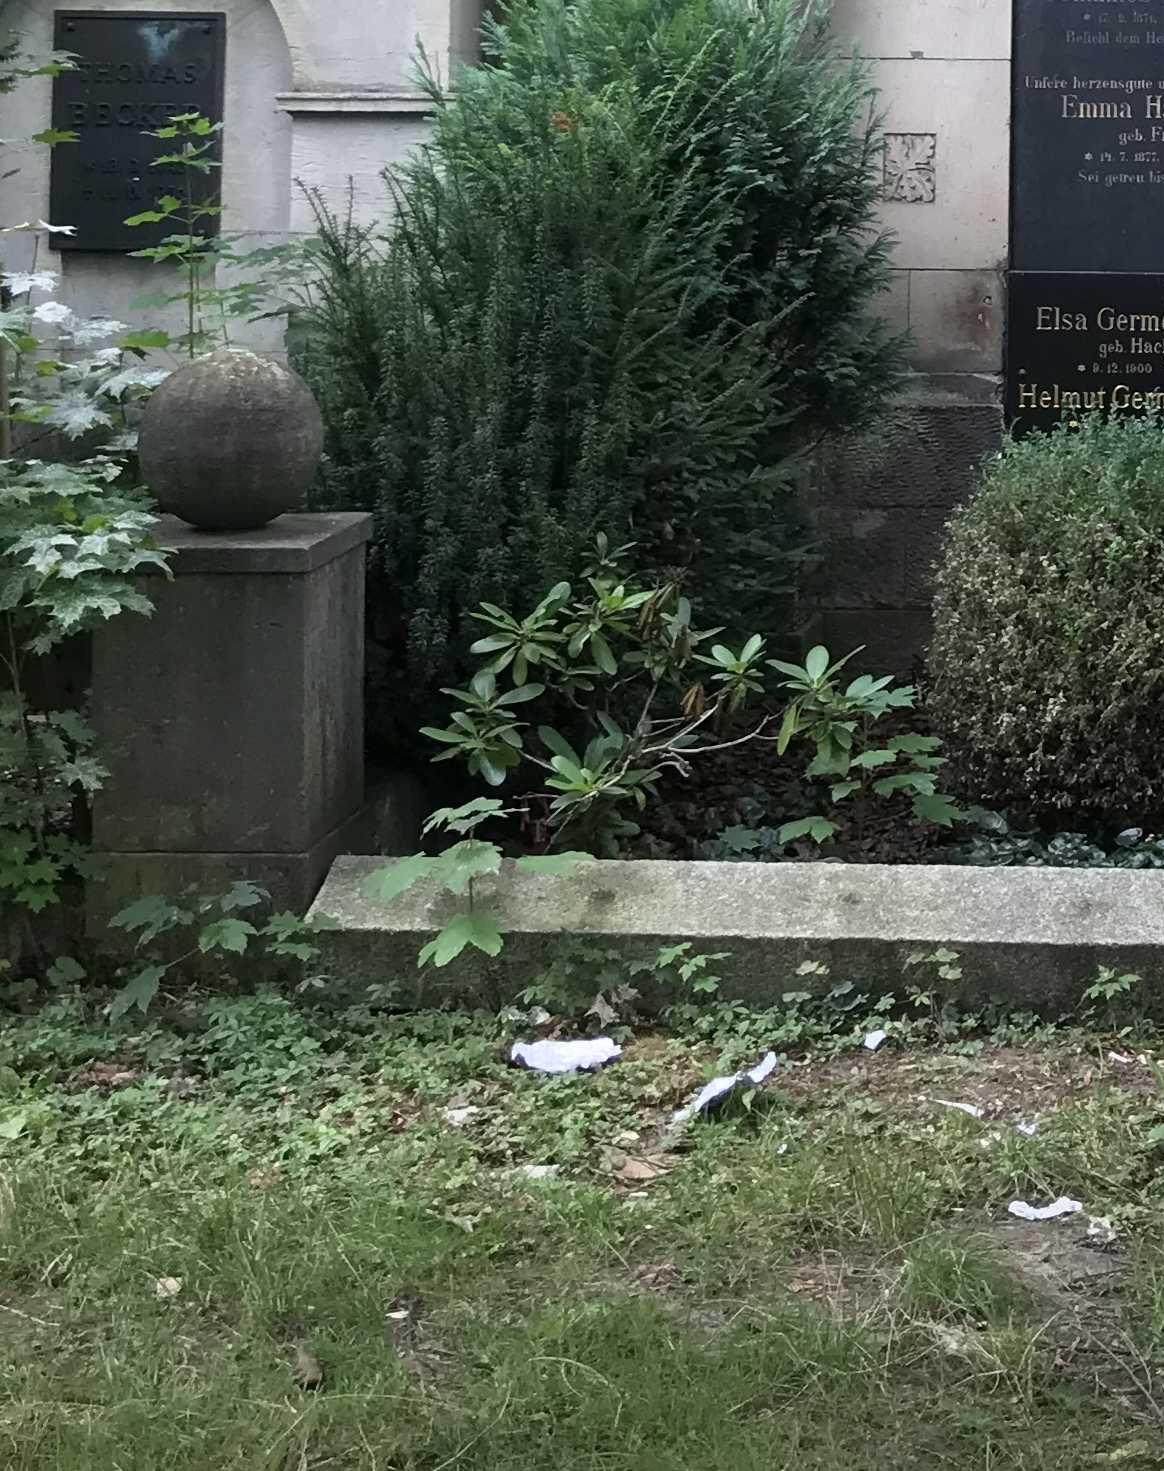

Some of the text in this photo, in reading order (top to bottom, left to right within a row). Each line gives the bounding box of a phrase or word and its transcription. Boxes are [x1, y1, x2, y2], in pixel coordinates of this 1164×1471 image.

[1116, 31, 1140, 45] dem
[1073, 76, 1153, 94] herzensgute
[1061, 94, 1132, 119] Emma
[1118, 128, 1145, 145] geb.
[1078, 170, 1100, 183] Sei
[1105, 171, 1144, 188] getreu
[1036, 306, 1088, 331] Elsa
[1099, 340, 1127, 358] geb.
[1018, 383, 1106, 409] Helmut
